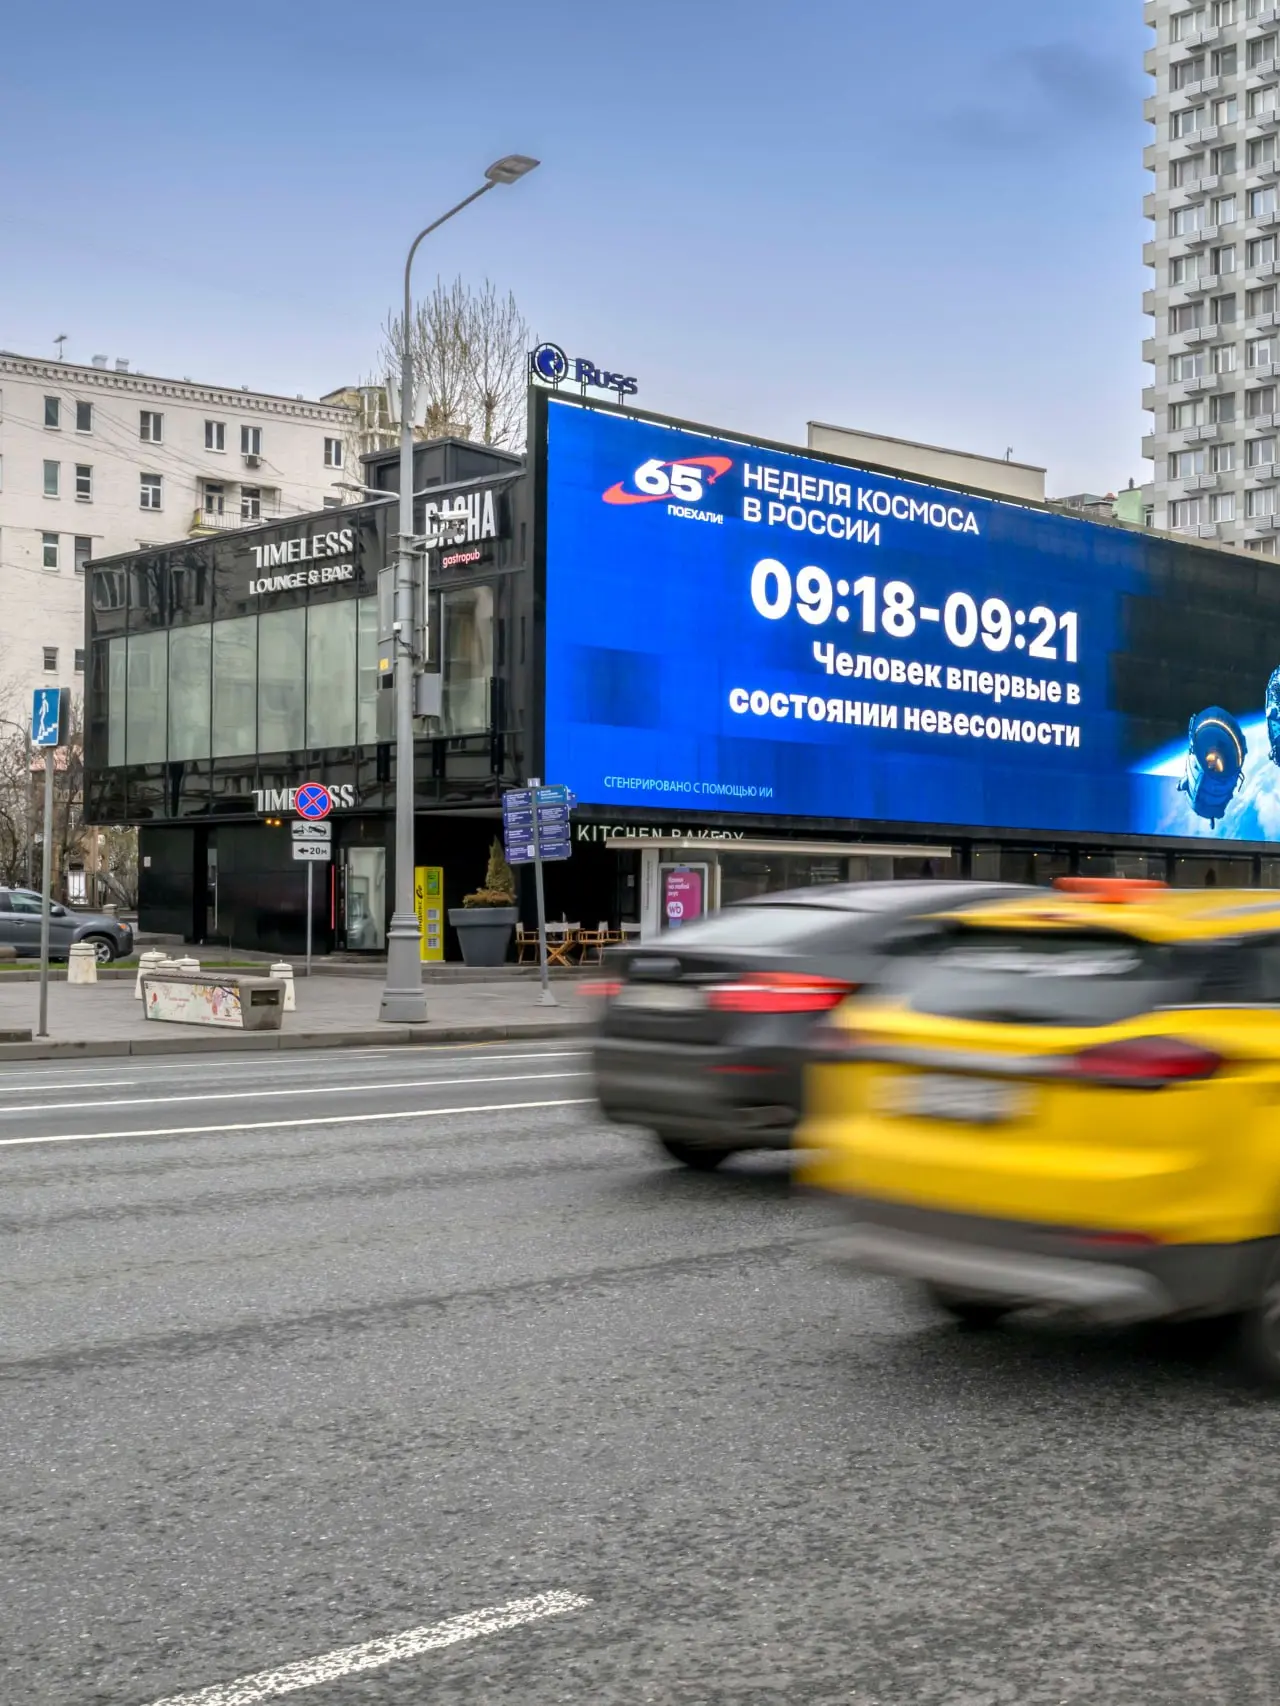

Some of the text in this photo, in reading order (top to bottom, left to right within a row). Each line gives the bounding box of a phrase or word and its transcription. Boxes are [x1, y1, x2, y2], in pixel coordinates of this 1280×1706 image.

[575, 358, 638, 395] Russ
[634, 459, 703, 502] 65
[743, 463, 980, 535] НЕДЕЛЯ КОСМОСА
[667, 504, 724, 525] ПОЕХАЛИ!
[743, 496, 880, 546] В РОССИИ
[250, 528, 353, 568] TIMELESS
[442, 547, 480, 569] gastropub
[249, 571, 307, 595] LOUNGE
[322, 564, 352, 583] BAR
[750, 558, 1079, 663] 09:18-09:21
[813, 641, 1081, 705] Человек впервые в
[729, 688, 1081, 748] состоянии невесомости
[252, 784, 355, 811] TIMESS
[604, 776, 692, 793] СГЕНЕРИРОВАНО
[702, 783, 757, 798] ПОМОЩЬЮ
[759, 787, 773, 798] ИИ
[577, 824, 662, 842] KITCHEN
